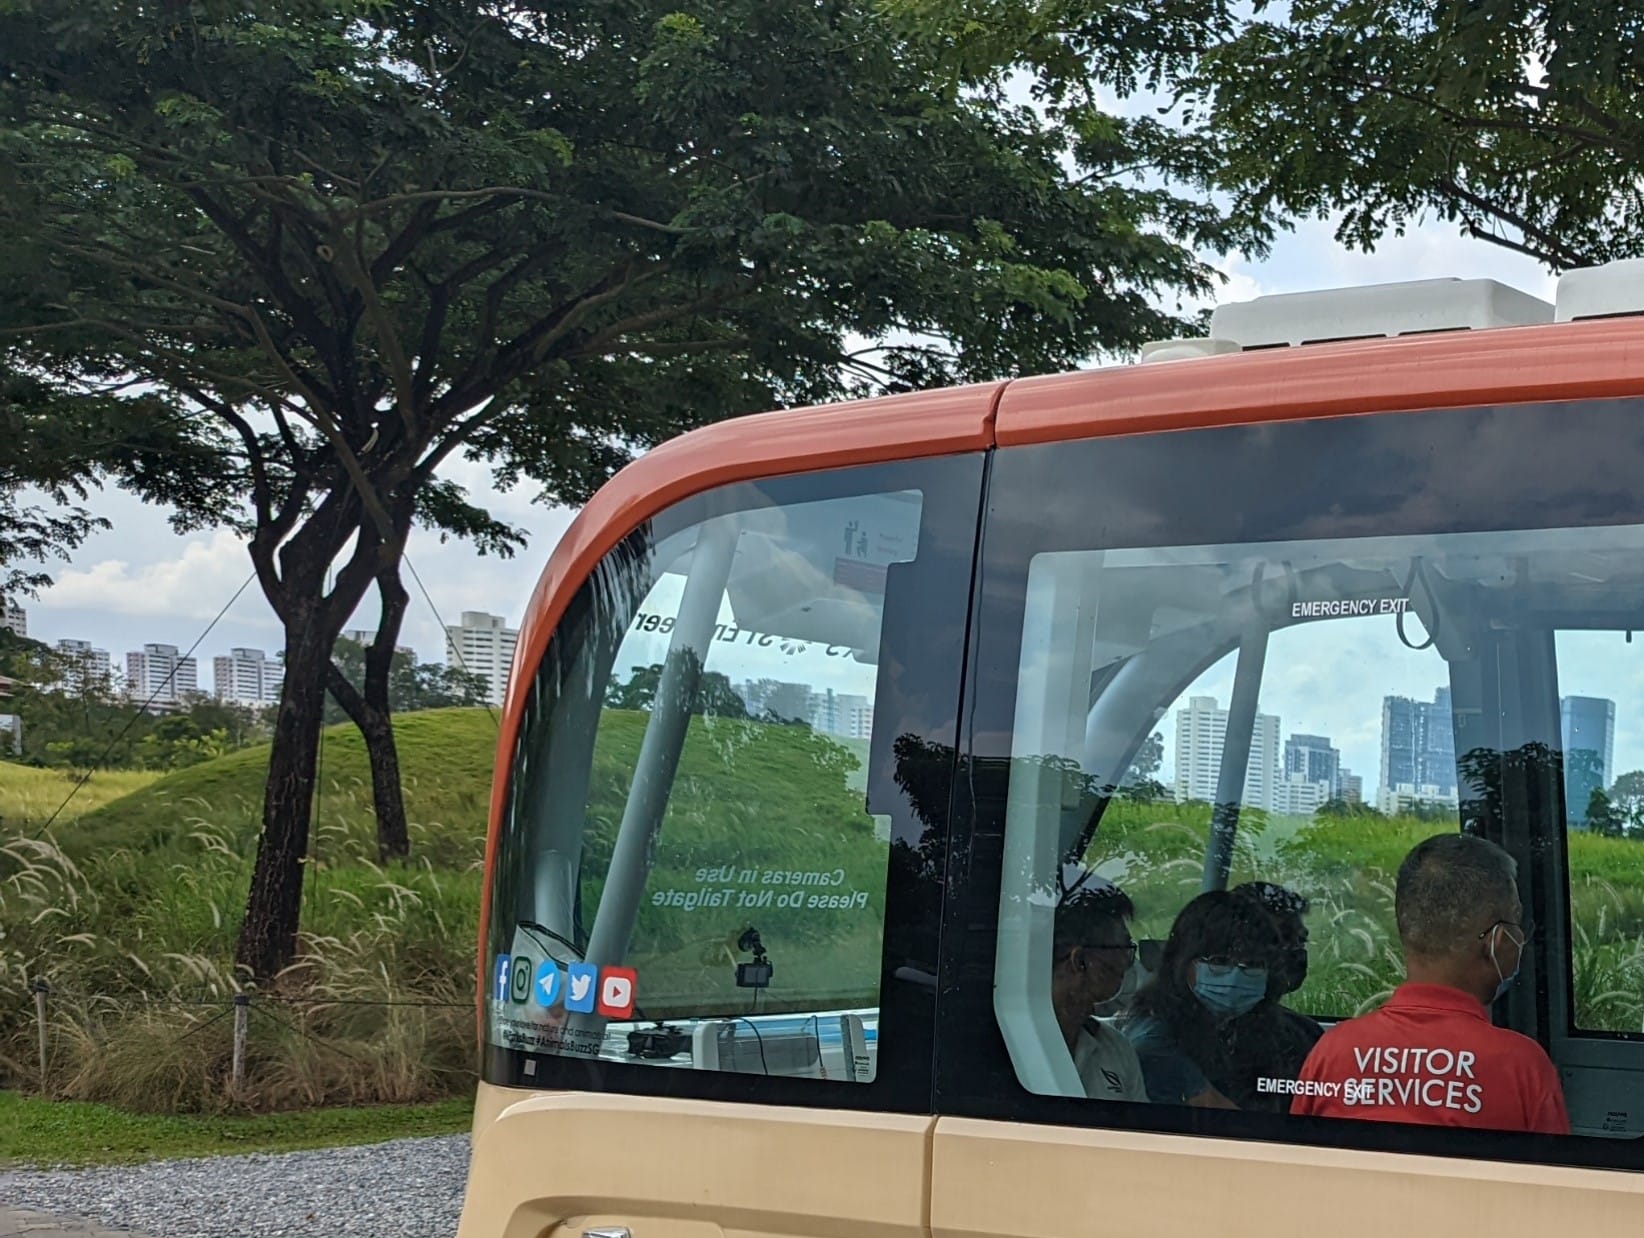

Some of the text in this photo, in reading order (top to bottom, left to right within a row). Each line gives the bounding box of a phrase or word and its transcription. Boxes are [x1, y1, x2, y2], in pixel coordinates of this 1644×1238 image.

[1291, 597, 1409, 618] EMERGENCY EXIT
[1354, 1047, 1475, 1078] VISITOR
[1256, 1077, 1373, 1099] EMERGENCY EXIT
[1342, 1078, 1483, 1113] SERVICES
